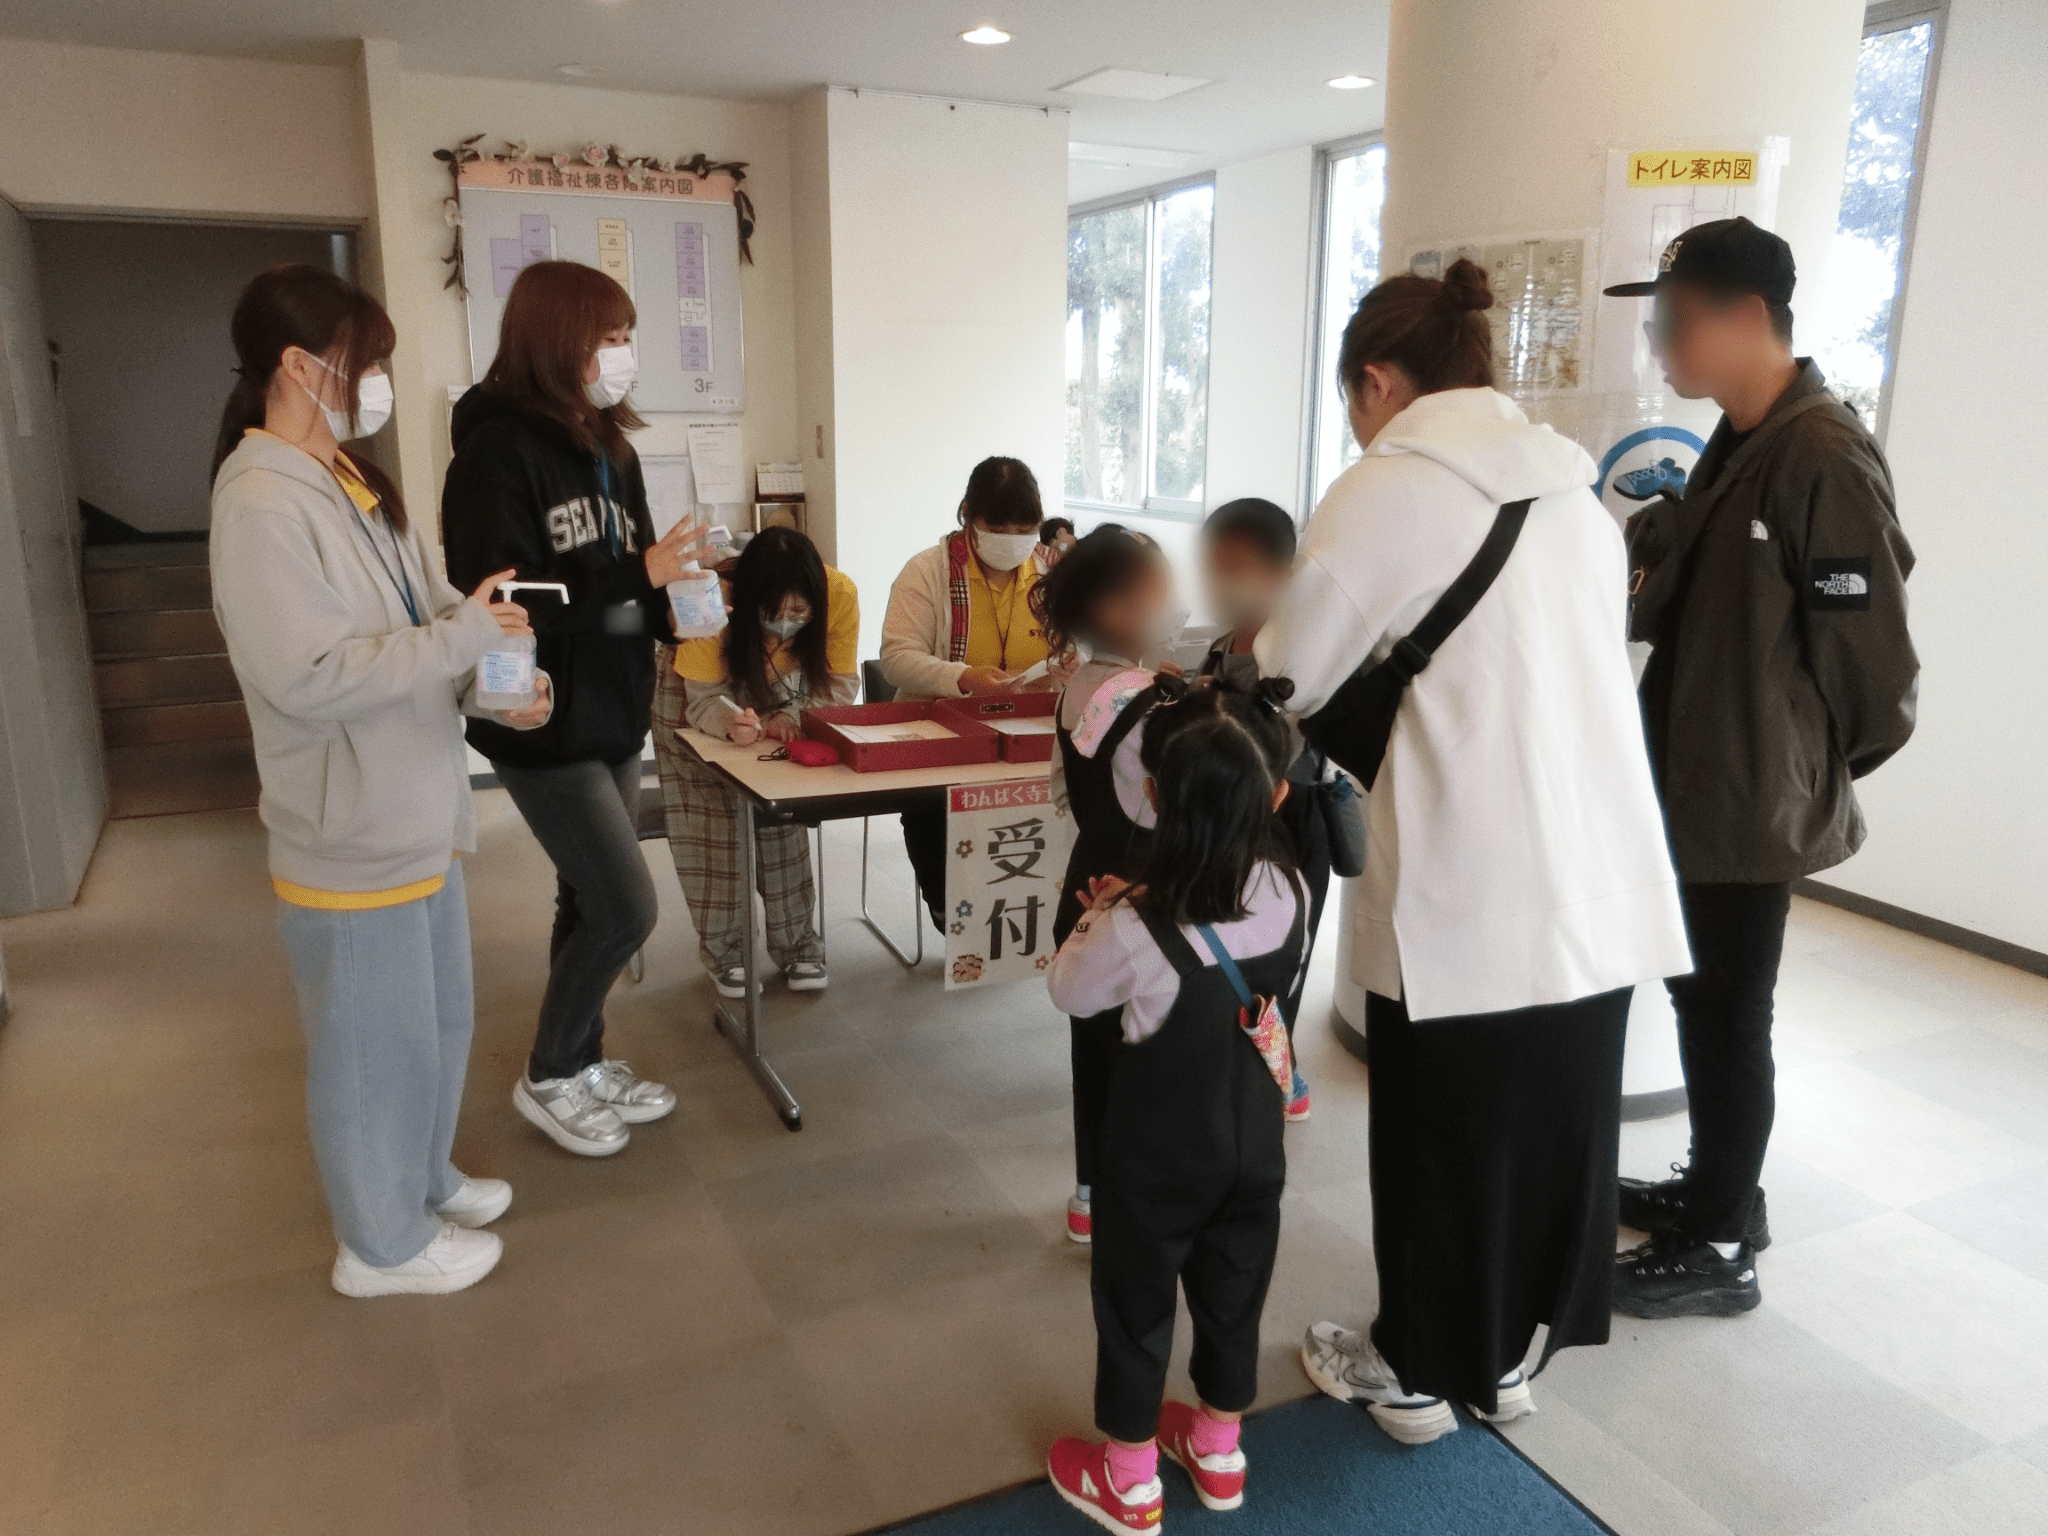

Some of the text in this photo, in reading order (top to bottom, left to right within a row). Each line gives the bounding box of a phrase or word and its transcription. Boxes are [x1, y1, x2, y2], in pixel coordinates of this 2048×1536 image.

[1636, 158, 1752, 180] トイレ案内図
[507, 167, 693, 195] 介護福祉棟各階案内図
[694, 378, 713, 393] 3F
[1814, 580, 1849, 588] NORTH
[1829, 573, 1849, 581] THE
[985, 817, 1046, 961] 受付
